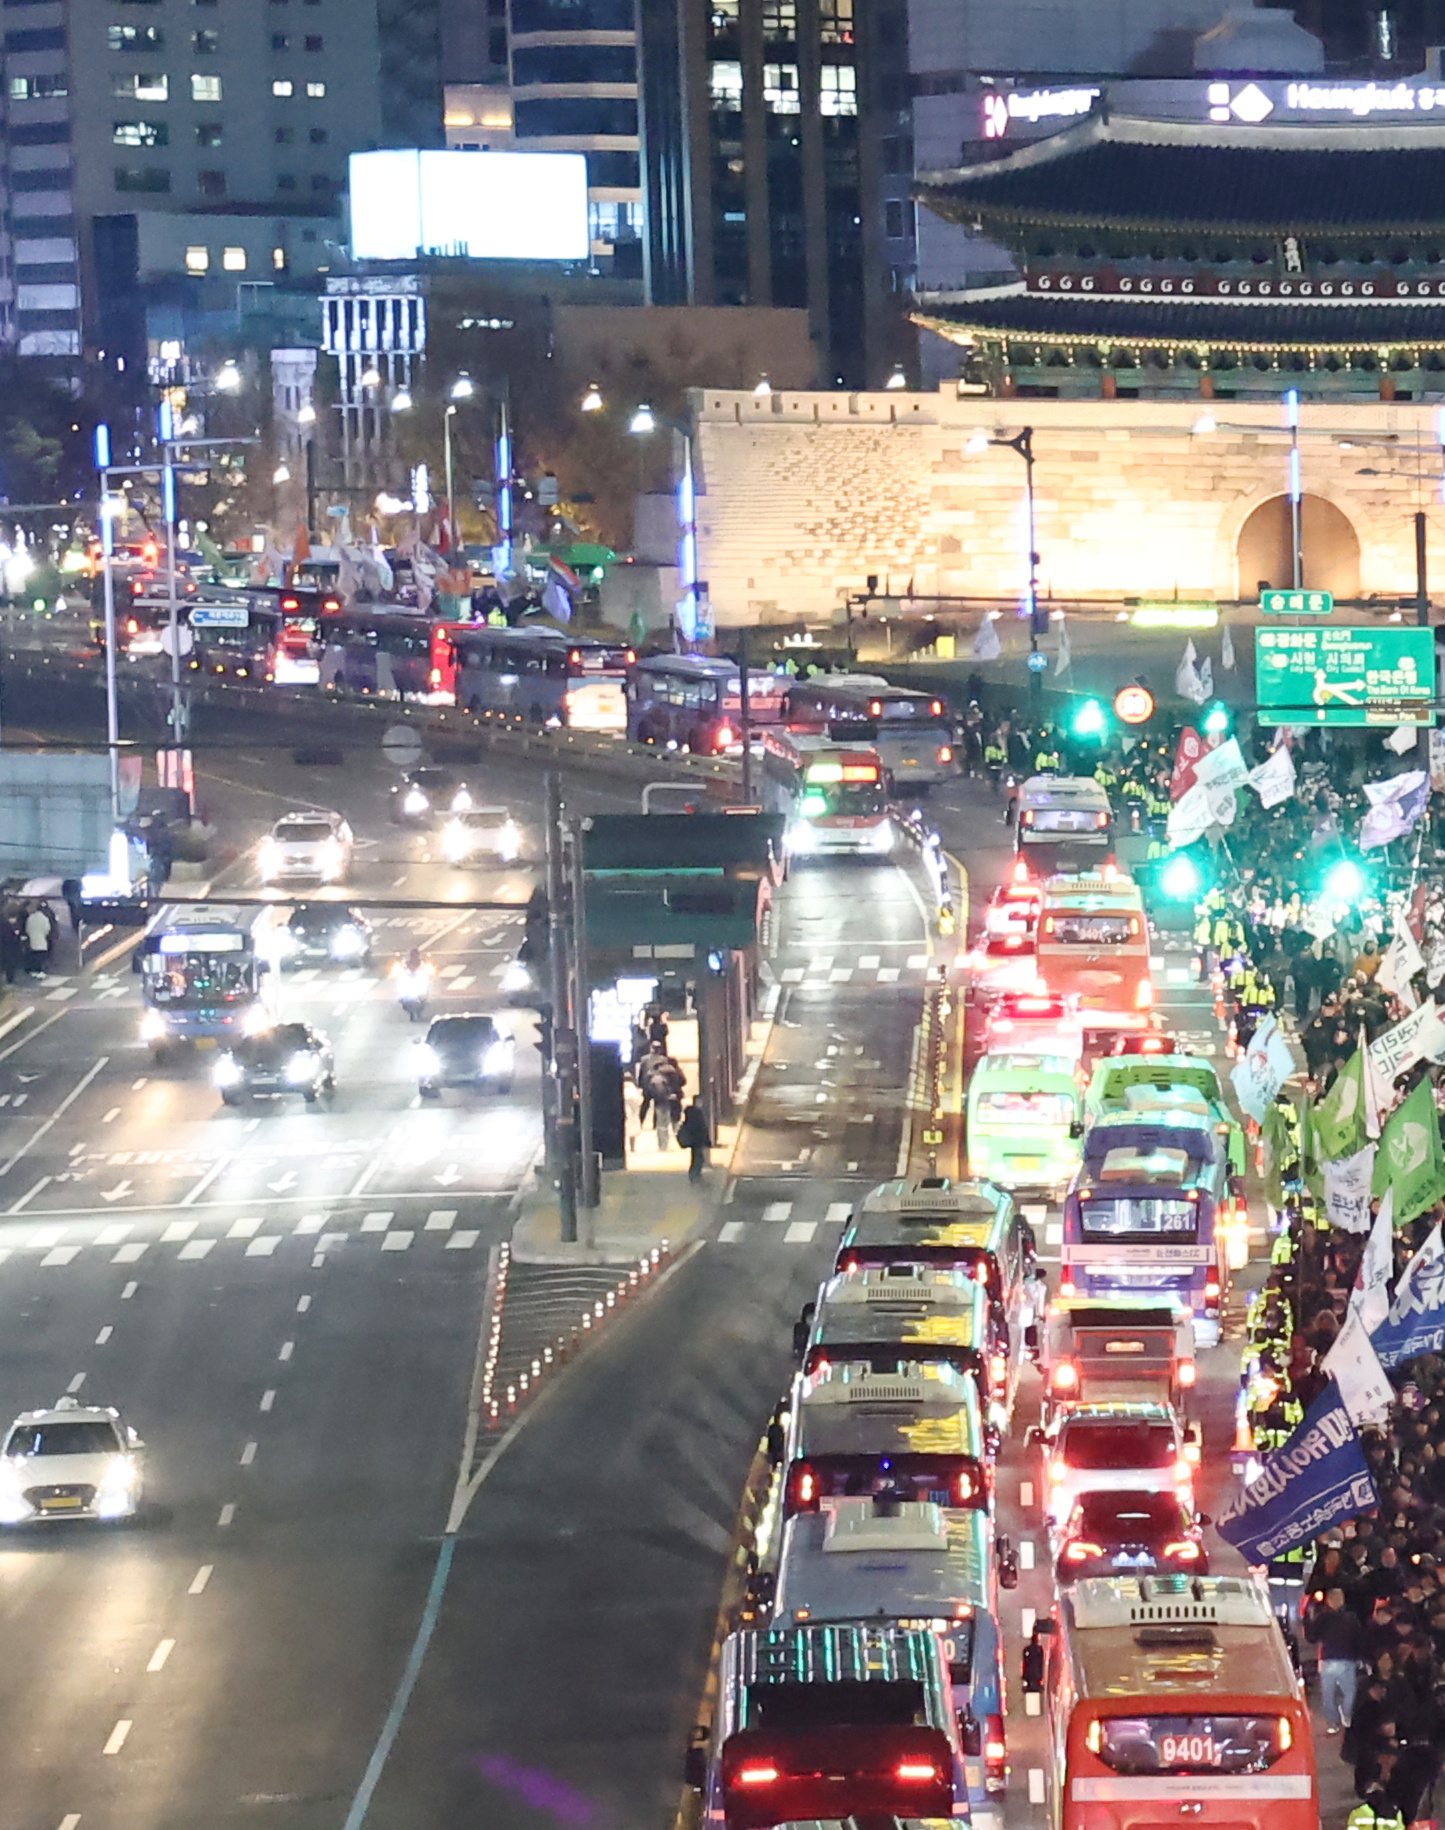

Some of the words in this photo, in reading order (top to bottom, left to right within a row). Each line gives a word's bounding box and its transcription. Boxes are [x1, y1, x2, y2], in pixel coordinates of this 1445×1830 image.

[1286, 84, 1414, 115] Heungkuk
[1290, 652, 1316, 665] 시청
[1164, 1215, 1190, 1230] 261
[1163, 1737, 1214, 1762] 9401
